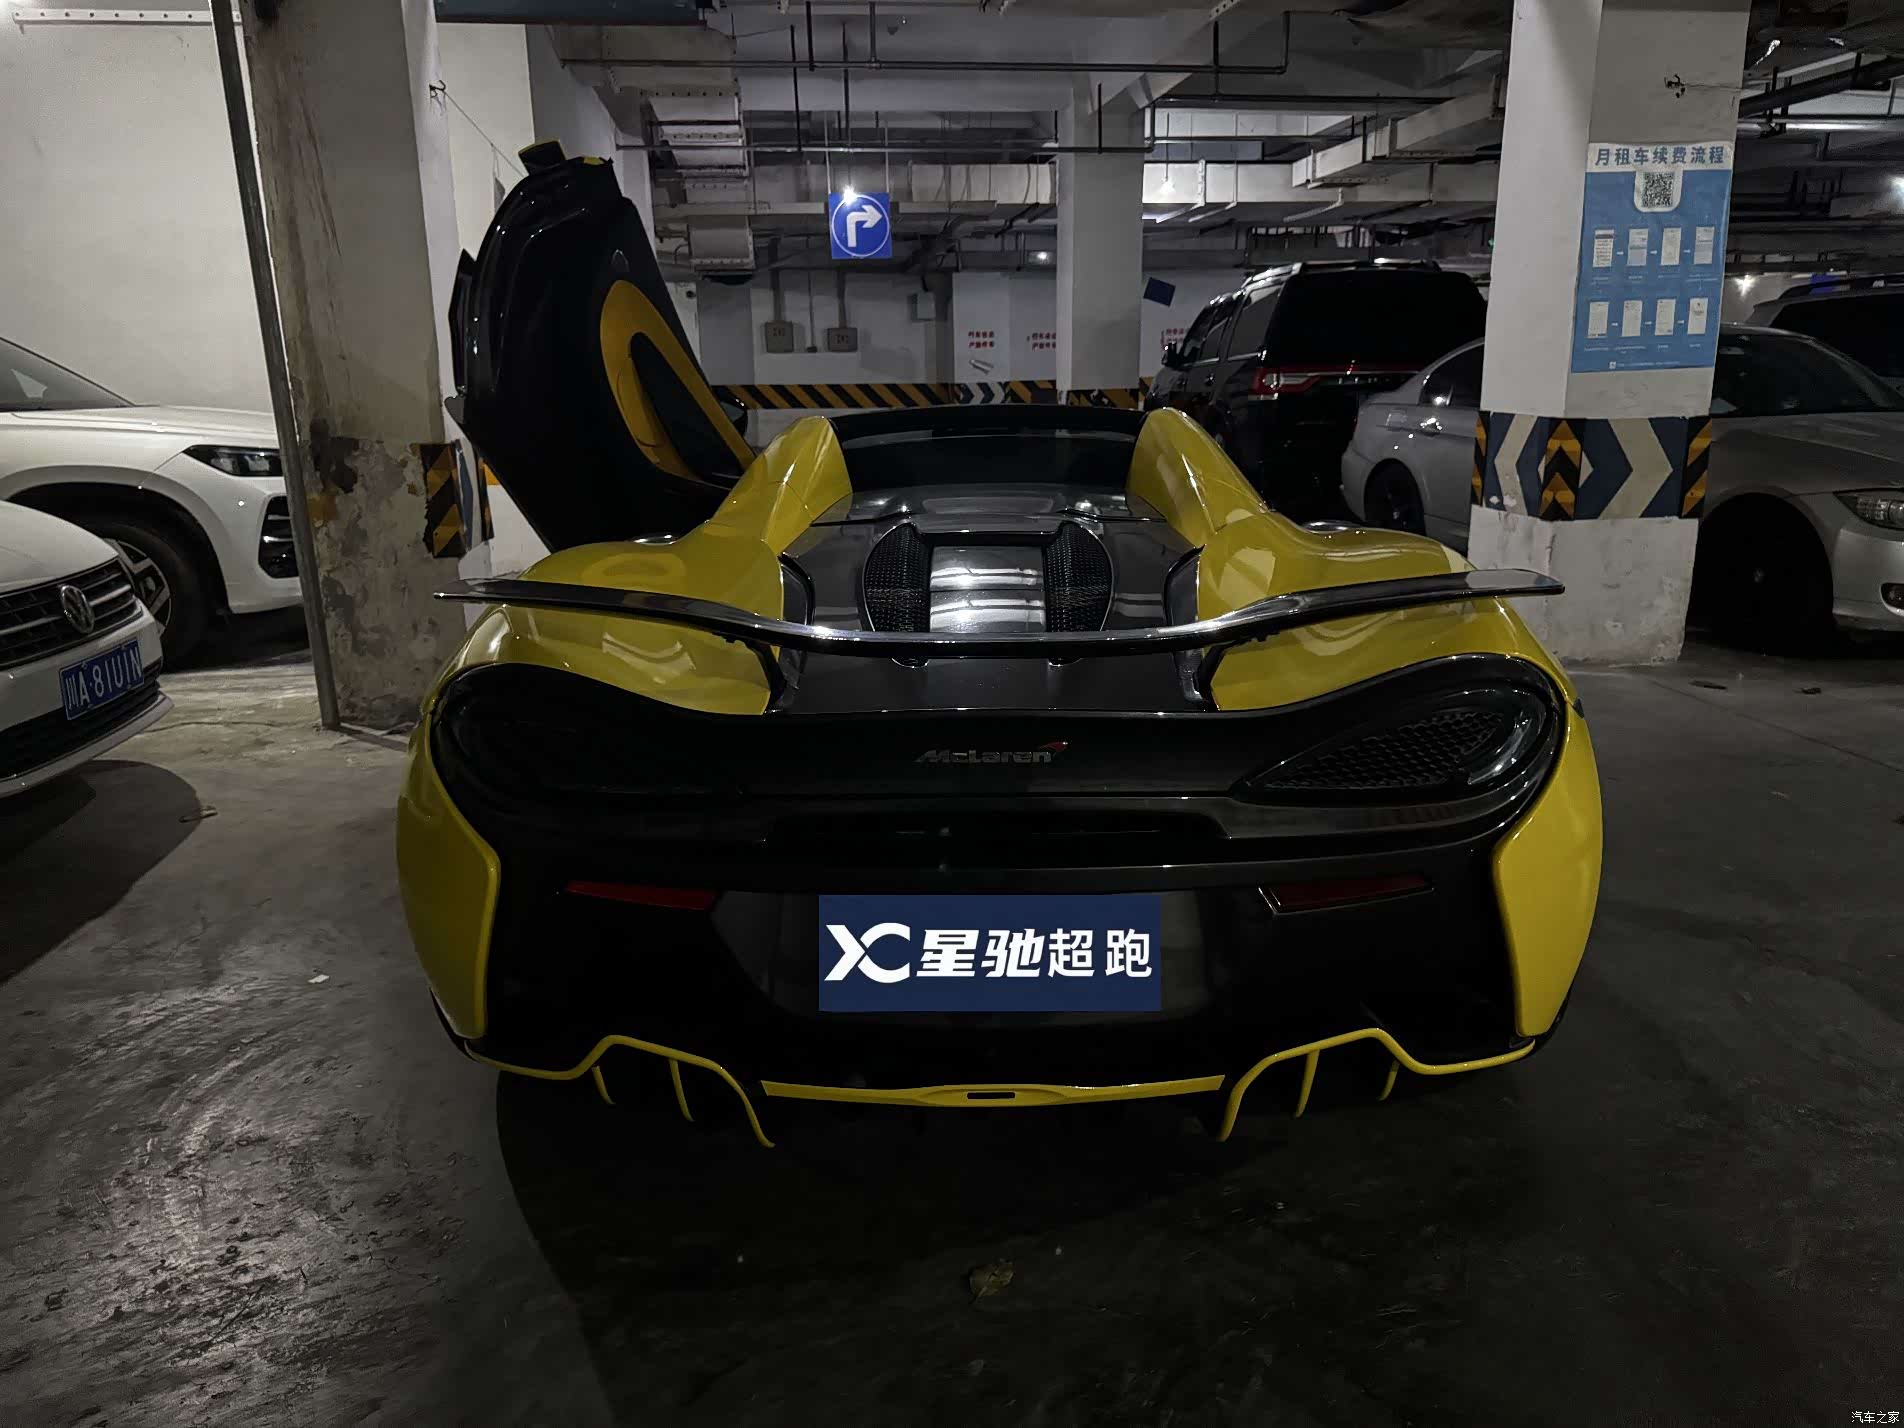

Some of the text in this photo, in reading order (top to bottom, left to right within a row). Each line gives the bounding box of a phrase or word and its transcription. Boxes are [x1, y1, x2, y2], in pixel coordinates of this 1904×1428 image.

[1595, 145, 1724, 166] 月租车续费流程
[913, 749, 1052, 763] McLaren
